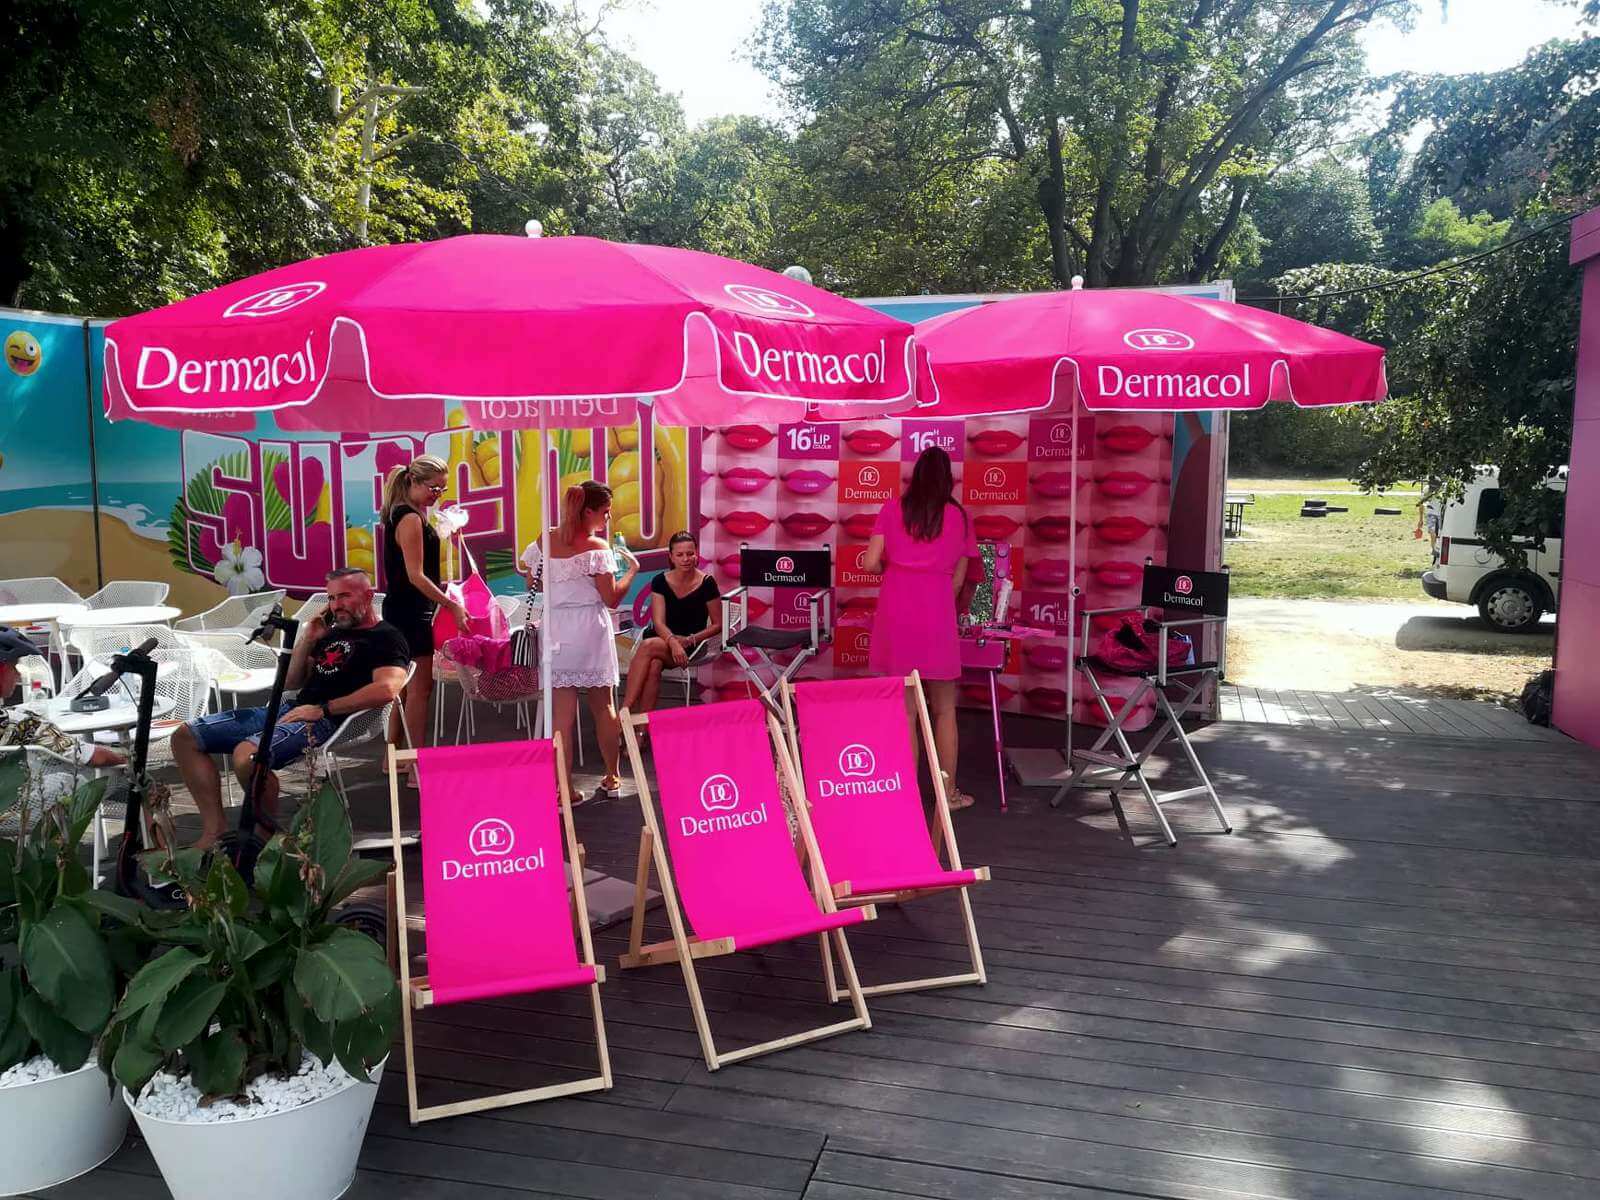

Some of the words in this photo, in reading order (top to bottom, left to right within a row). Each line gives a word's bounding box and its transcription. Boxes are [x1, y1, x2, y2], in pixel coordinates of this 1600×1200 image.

[136, 332, 316, 394] Dermacol
[734, 330, 885, 385] Dermacol
[1097, 362, 1252, 398] Dermacol
[1035, 444, 1086, 457] Dermaol
[844, 487, 893, 499] Dermacol
[969, 489, 1019, 501] Dermacol
[764, 572, 806, 584] Dermacol
[1163, 591, 1204, 607] Dermacol
[818, 772, 901, 797] Dermacol
[680, 802, 768, 837] Dermacol
[441, 848, 545, 880] Dermacol
